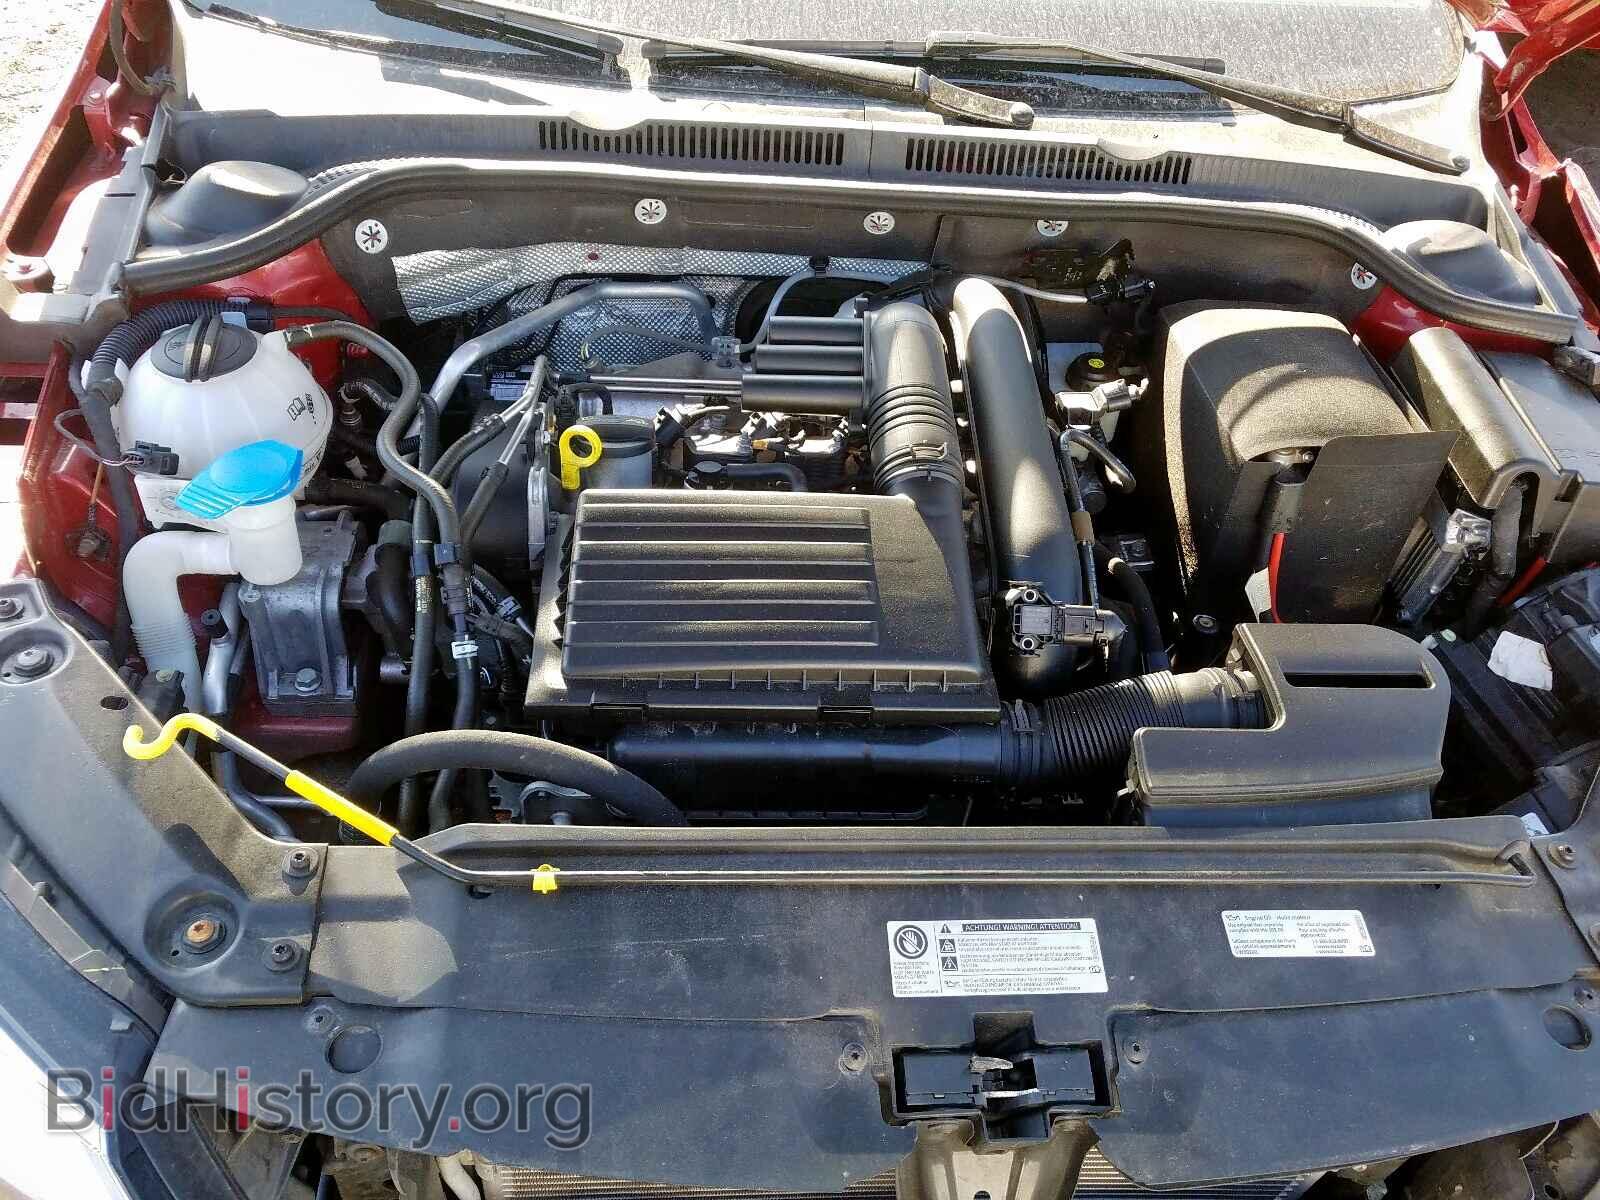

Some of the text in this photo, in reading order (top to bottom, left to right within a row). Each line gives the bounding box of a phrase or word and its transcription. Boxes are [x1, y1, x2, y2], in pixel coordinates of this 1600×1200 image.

[965, 922, 1079, 931] ACHTUNG! WARNING! ATTENTION!
